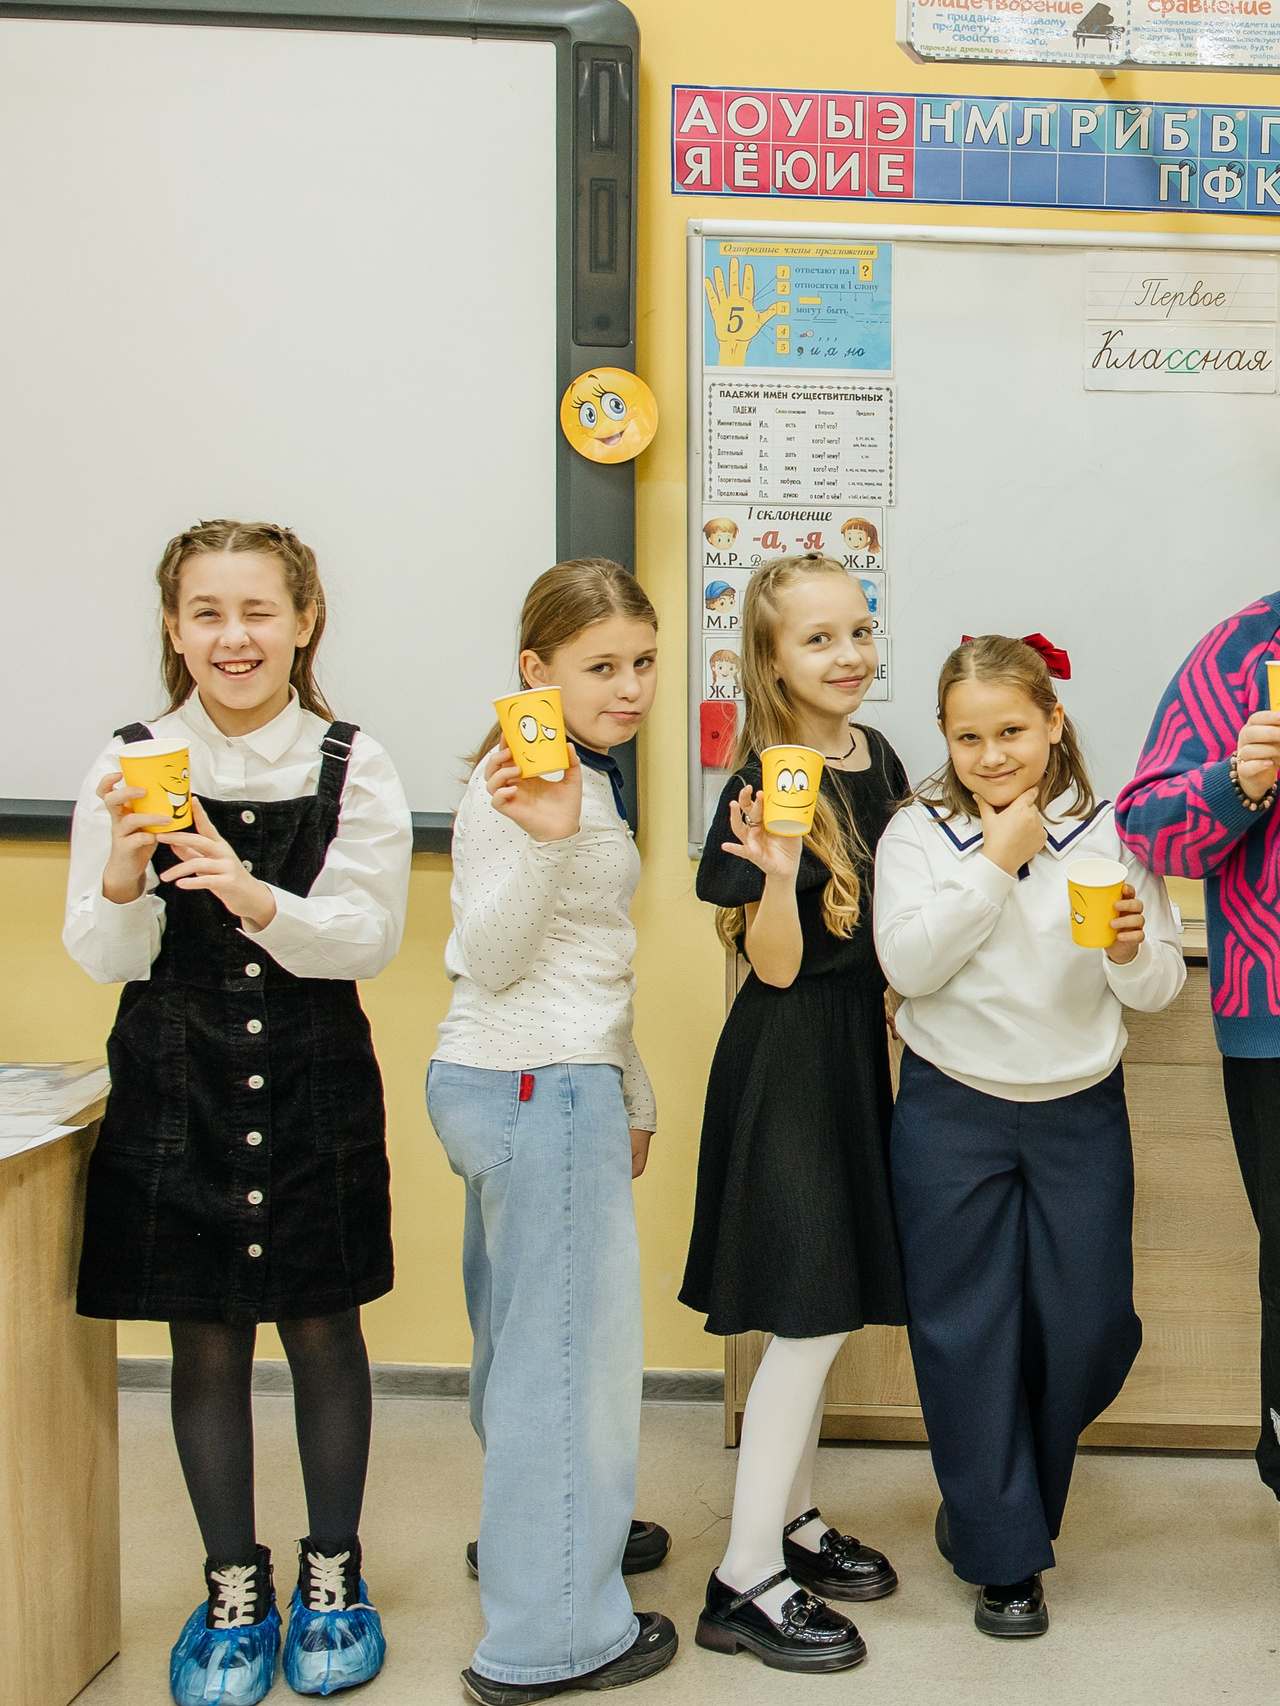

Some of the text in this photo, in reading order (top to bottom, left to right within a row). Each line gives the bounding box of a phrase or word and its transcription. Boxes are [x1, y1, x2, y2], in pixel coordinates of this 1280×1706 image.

[1148, 0, 1272, 18] сравнение
[933, 23, 990, 34] предмету
[952, 34, 1000, 42] свойств
[679, 94, 718, 134] А
[726, 95, 768, 137] О
[777, 98, 813, 138] У
[826, 100, 864, 140] Ы
[876, 101, 908, 141] Э
[920, 102, 956, 144] Н
[964, 104, 1008, 146] М
[1016, 106, 1054, 147] Л
[1071, 108, 1100, 148] Р
[1115, 106, 1150, 150] Й
[1162, 113, 1192, 152] Б
[1211, 115, 1236, 154] В
[682, 146, 712, 185] Я
[733, 142, 760, 188] Ё
[774, 149, 818, 190] Ю
[825, 150, 860, 191] И
[880, 154, 905, 192] Е
[1158, 164, 1190, 202] П
[1202, 166, 1243, 203] Ф
[723, 244, 780, 254] Однородные
[815, 248, 874, 256] предложения
[794, 282, 879, 292] относятся слову
[1134, 278, 1226, 318] Первое
[727, 306, 744, 333] 5
[1091, 329, 1272, 371] Классная
[720, 390, 884, 402] ПАДЕЖИ ИМЁН СУЩЕСТВИТЕЛЬНЫХ
[732, 406, 756, 414] ПАДЕЖИ
[756, 508, 833, 521] склонение
[706, 552, 742, 566] М.Р.
